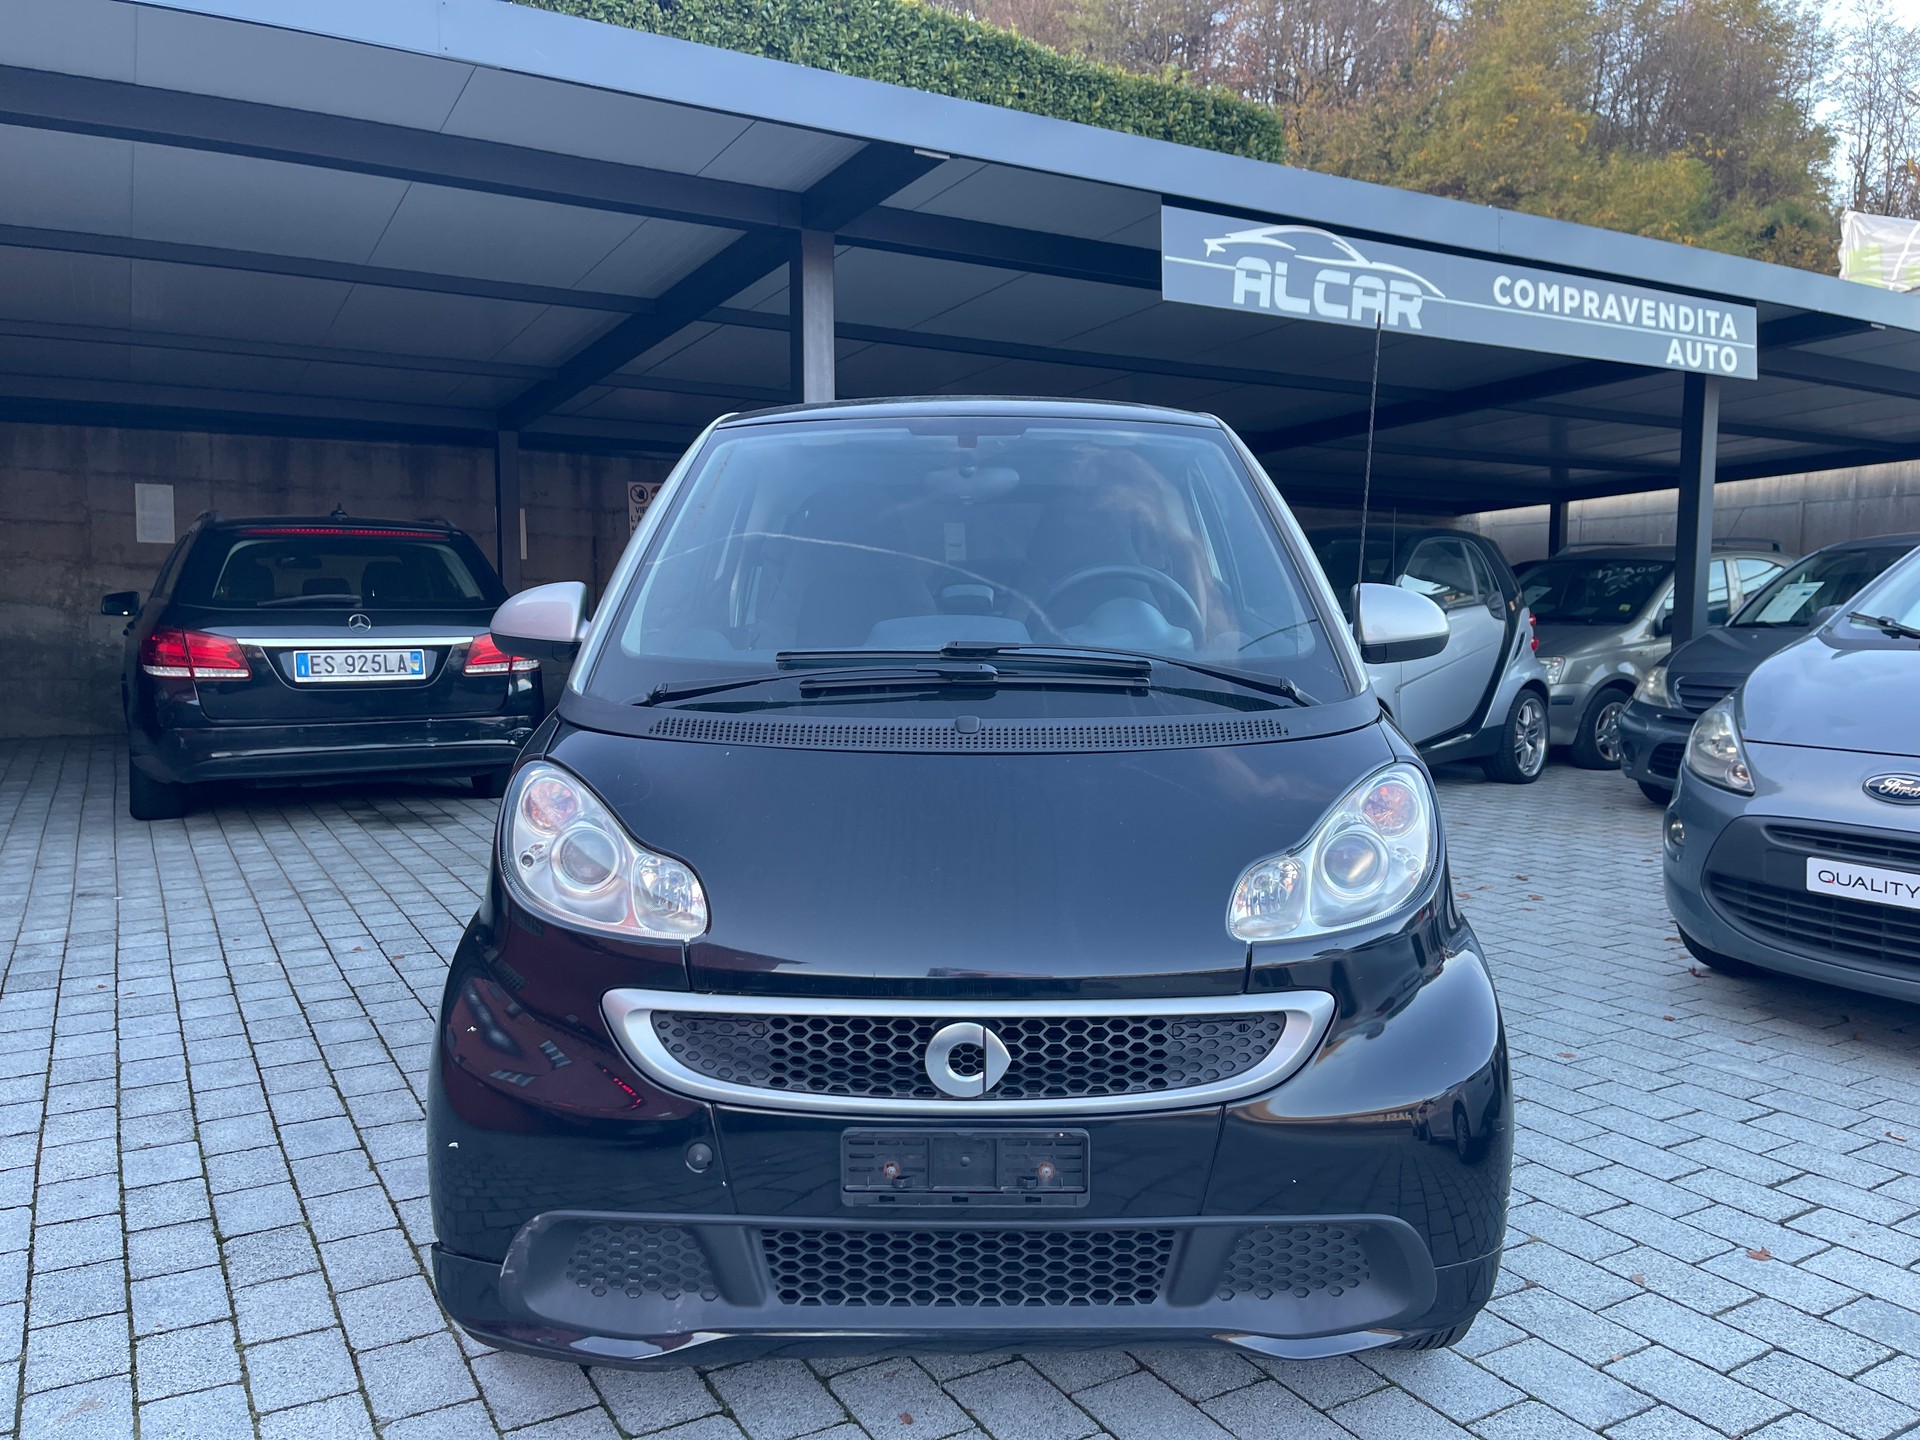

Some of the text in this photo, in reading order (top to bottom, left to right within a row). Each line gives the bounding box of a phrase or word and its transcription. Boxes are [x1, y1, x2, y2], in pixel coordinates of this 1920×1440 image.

[1233, 256, 1423, 330] ALCAR
[1493, 275, 1738, 340] COMPRAVENDITA
[1666, 338, 1738, 373] AUTO
[310, 655, 335, 674] ES
[344, 654, 408, 673] 925LA
[1818, 870, 1920, 899] QUALITY
